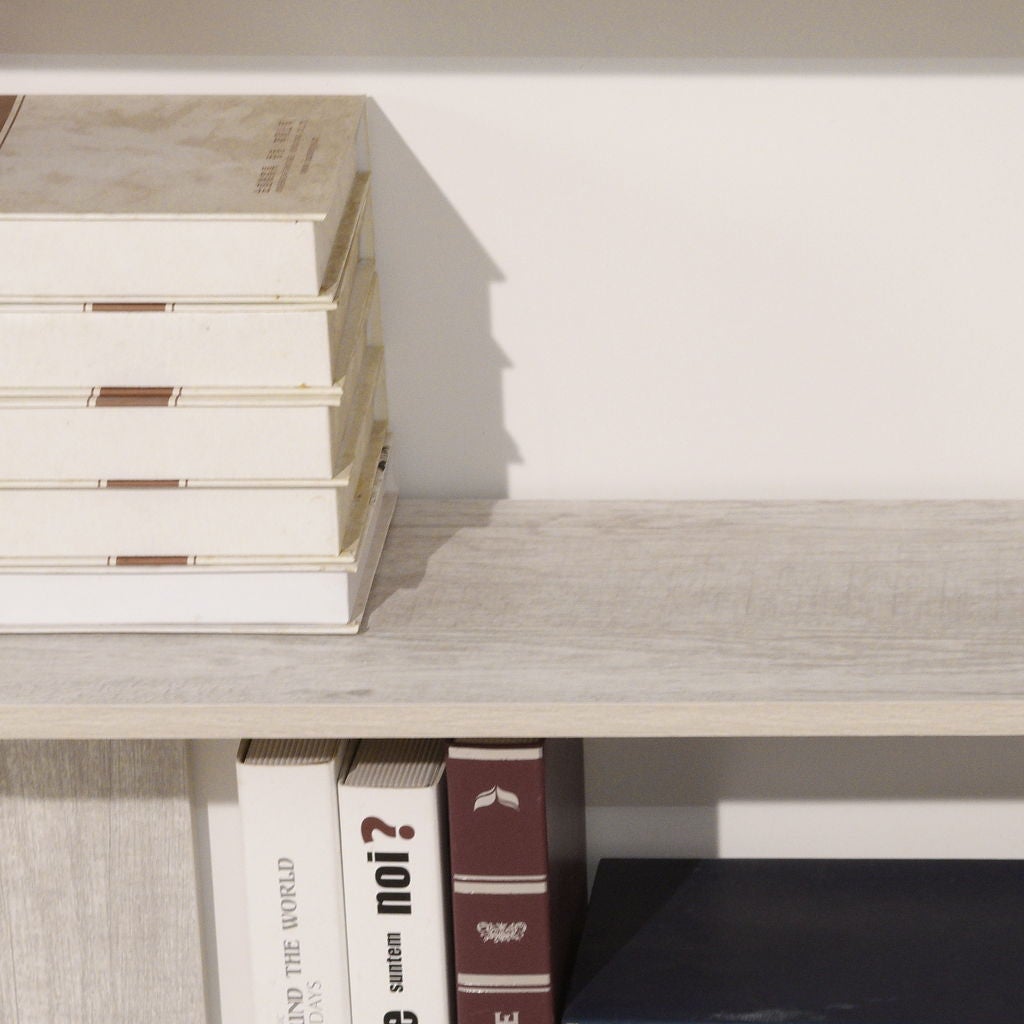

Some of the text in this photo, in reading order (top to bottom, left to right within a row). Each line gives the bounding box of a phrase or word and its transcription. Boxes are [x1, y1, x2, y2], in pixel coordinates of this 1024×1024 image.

[278, 857, 299, 930] WORLD
[283, 939, 302, 978] THE
[387, 932, 404, 993] suntem
[306, 979, 324, 1024] DAYS
